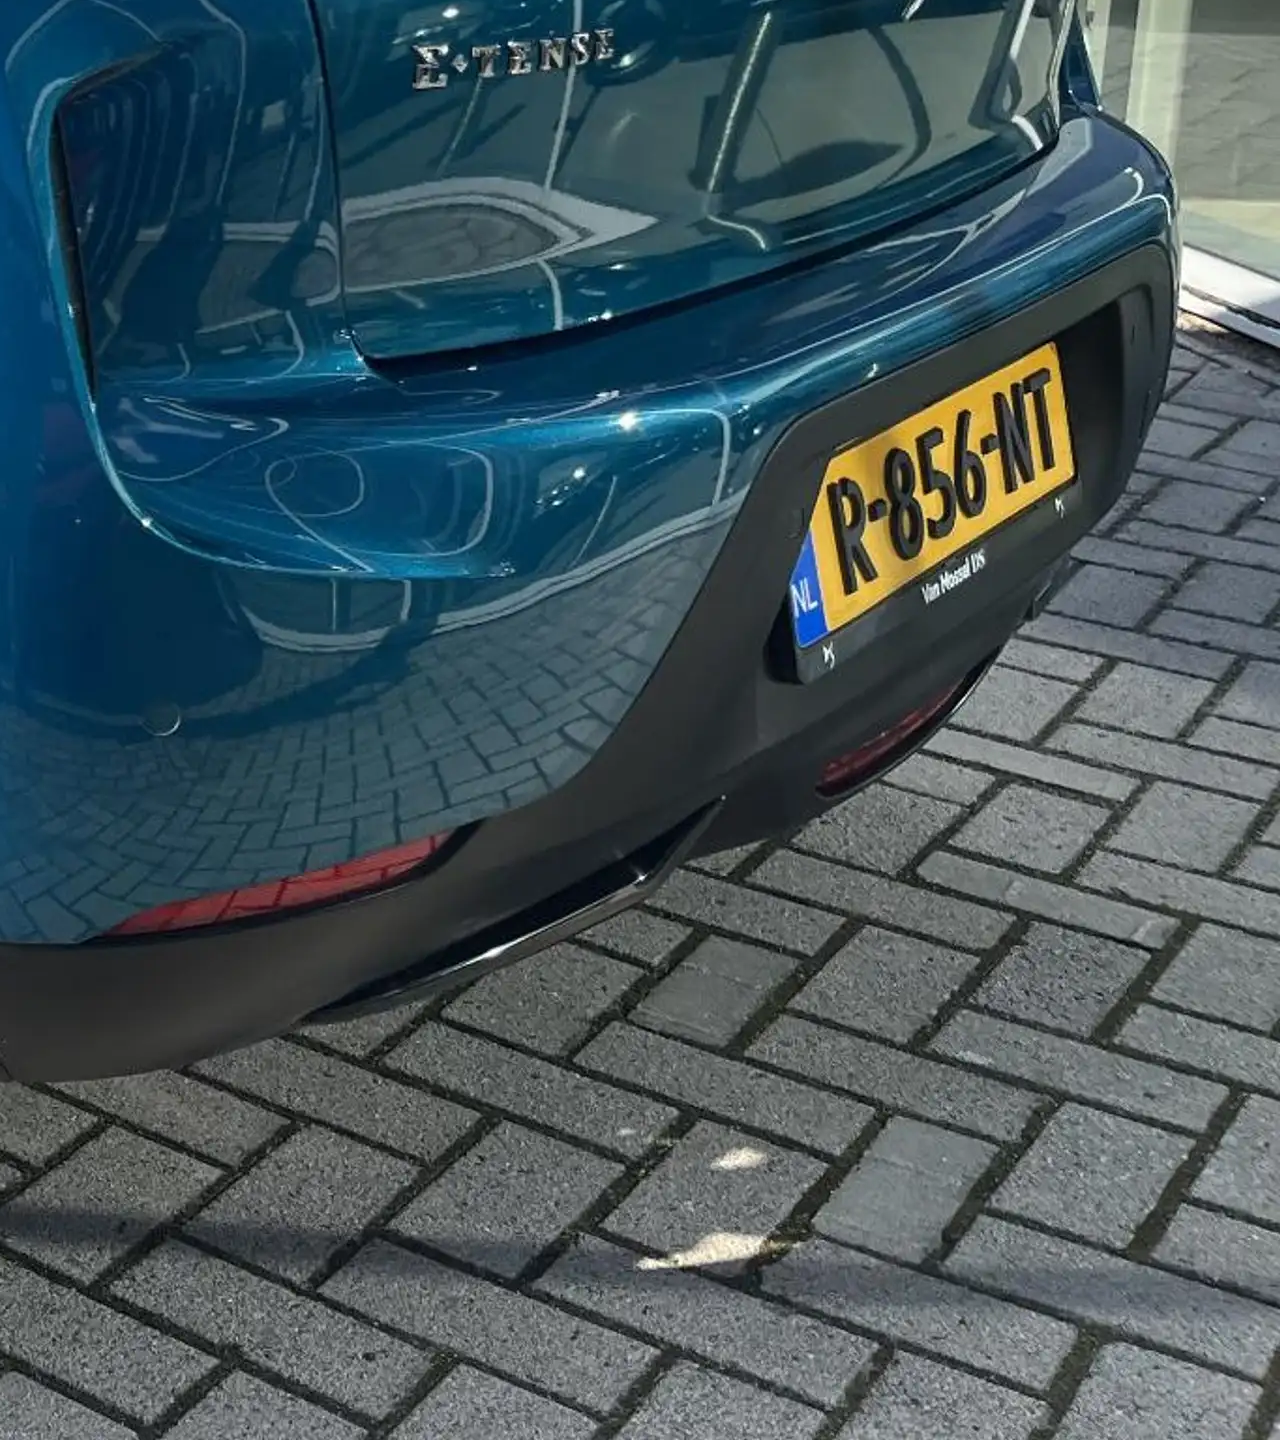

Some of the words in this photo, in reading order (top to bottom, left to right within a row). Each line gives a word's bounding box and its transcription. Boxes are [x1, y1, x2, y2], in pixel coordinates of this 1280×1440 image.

[826, 367, 1056, 595] R-856-NT
[791, 577, 818, 618] NL
[921, 583, 941, 604] Van
